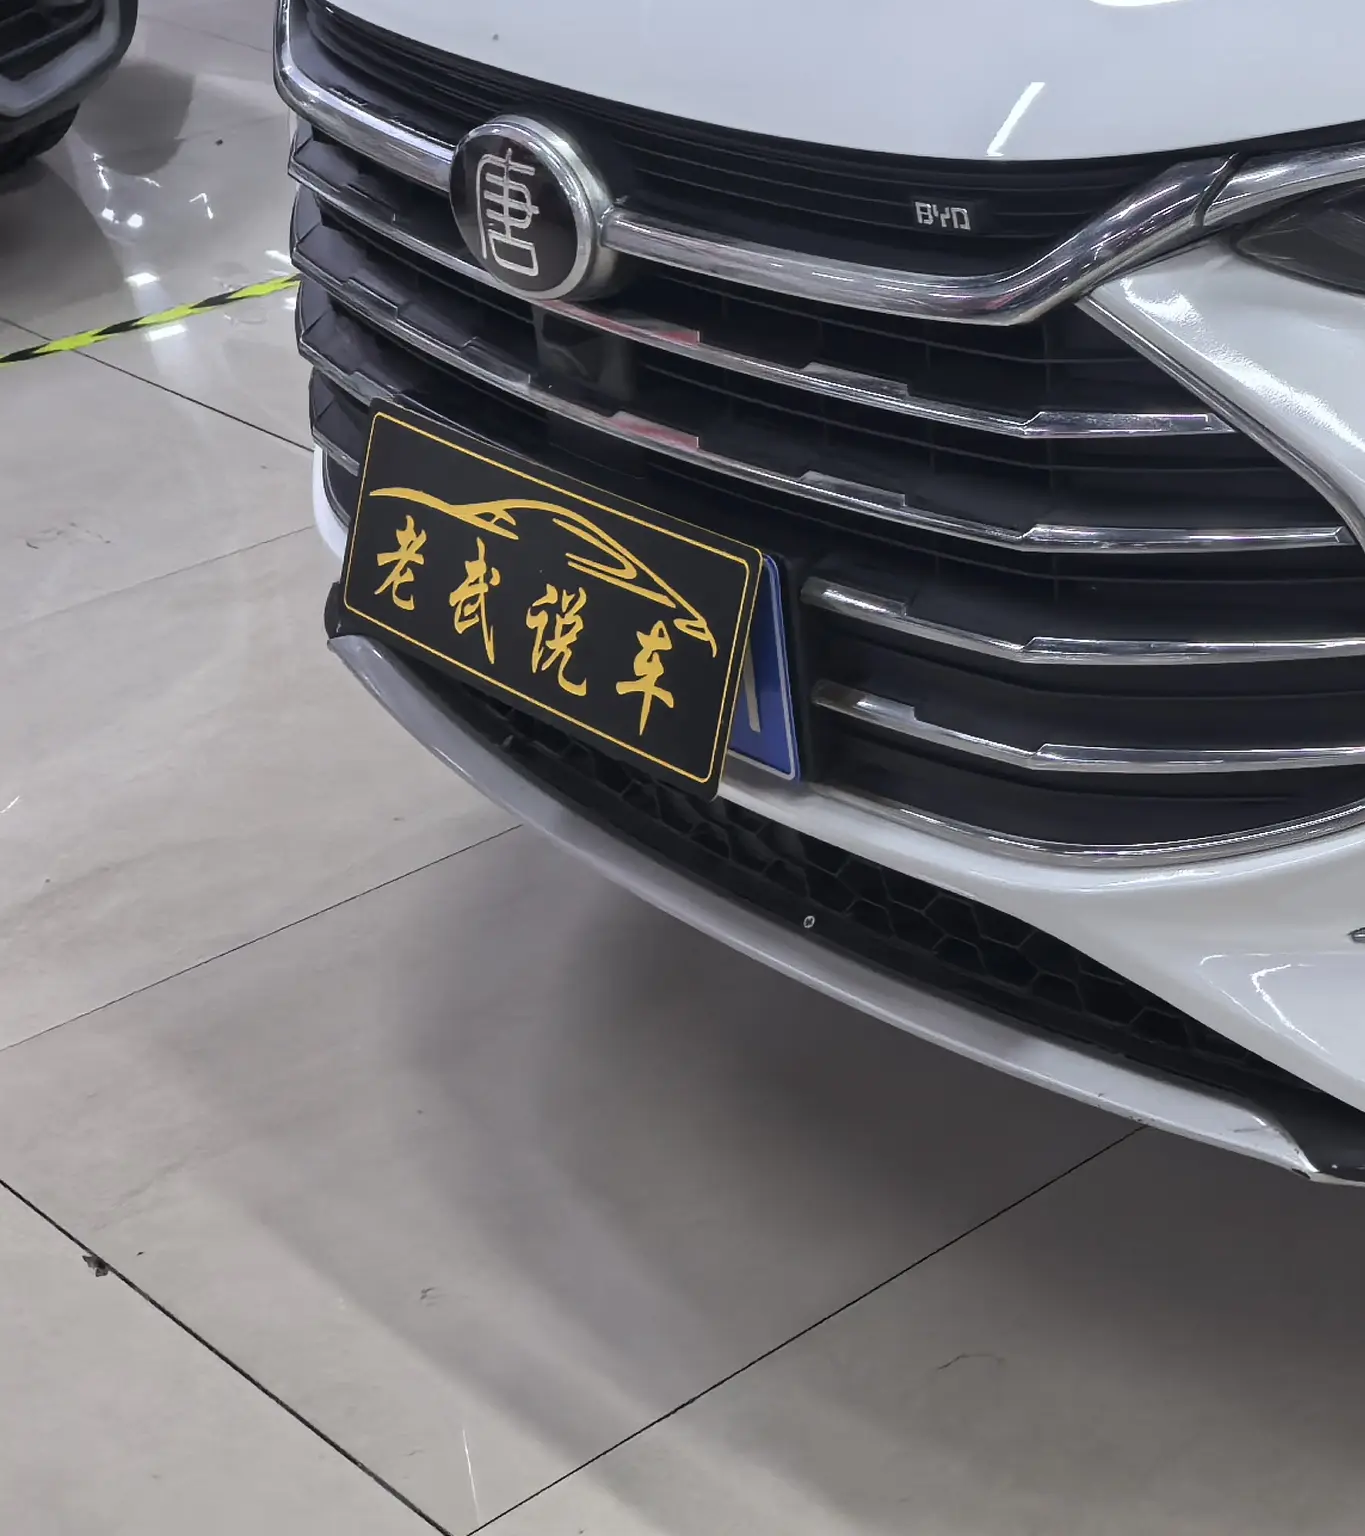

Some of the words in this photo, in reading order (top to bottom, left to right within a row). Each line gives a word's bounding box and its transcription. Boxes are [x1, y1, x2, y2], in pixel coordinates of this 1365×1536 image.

[476, 147, 540, 277] 唐
[914, 201, 971, 231] BYD
[374, 514, 675, 736] 老武说车
